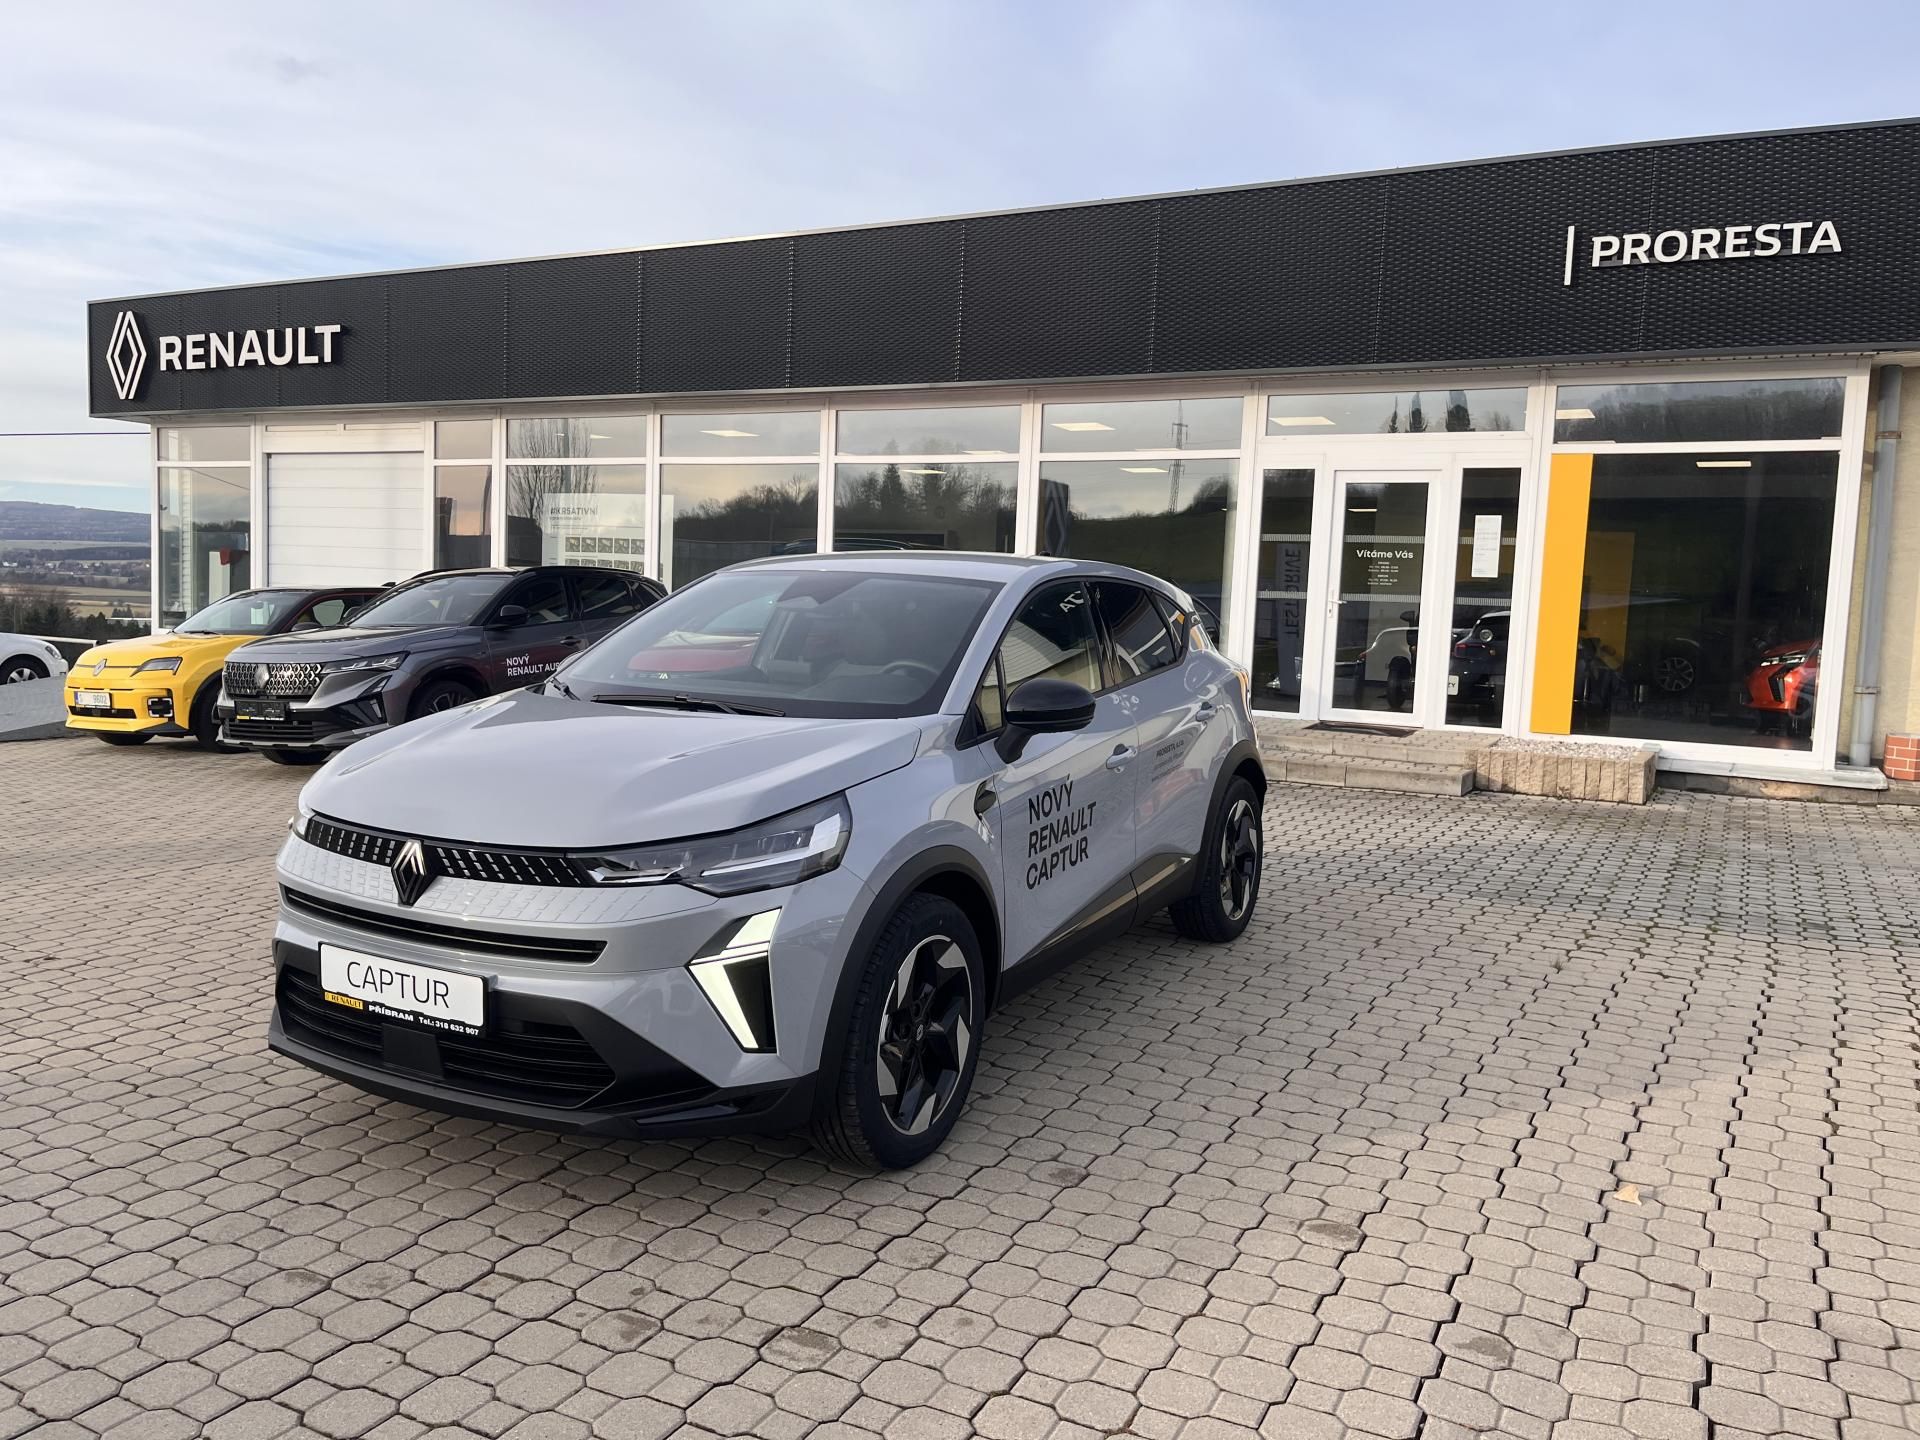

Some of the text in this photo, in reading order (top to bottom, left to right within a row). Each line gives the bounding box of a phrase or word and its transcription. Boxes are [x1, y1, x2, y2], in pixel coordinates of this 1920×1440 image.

[1591, 220, 1842, 268] PRORESTA
[159, 324, 341, 371] RENAULT
[1356, 549, 1414, 559] Vítáme Vás
[506, 653, 530, 667] NOVÝ
[507, 664, 544, 677] RENAULT
[1028, 773, 1073, 824] NOVÝ
[1028, 801, 1096, 858] RENAULT
[1026, 836, 1089, 890] CAPTUR
[346, 961, 450, 1009] CAPTUR
[331, 995, 362, 1009] RENAULT
[368, 1004, 414, 1021] PŘÍBRAM
[450, 1024, 464, 1033] 632
